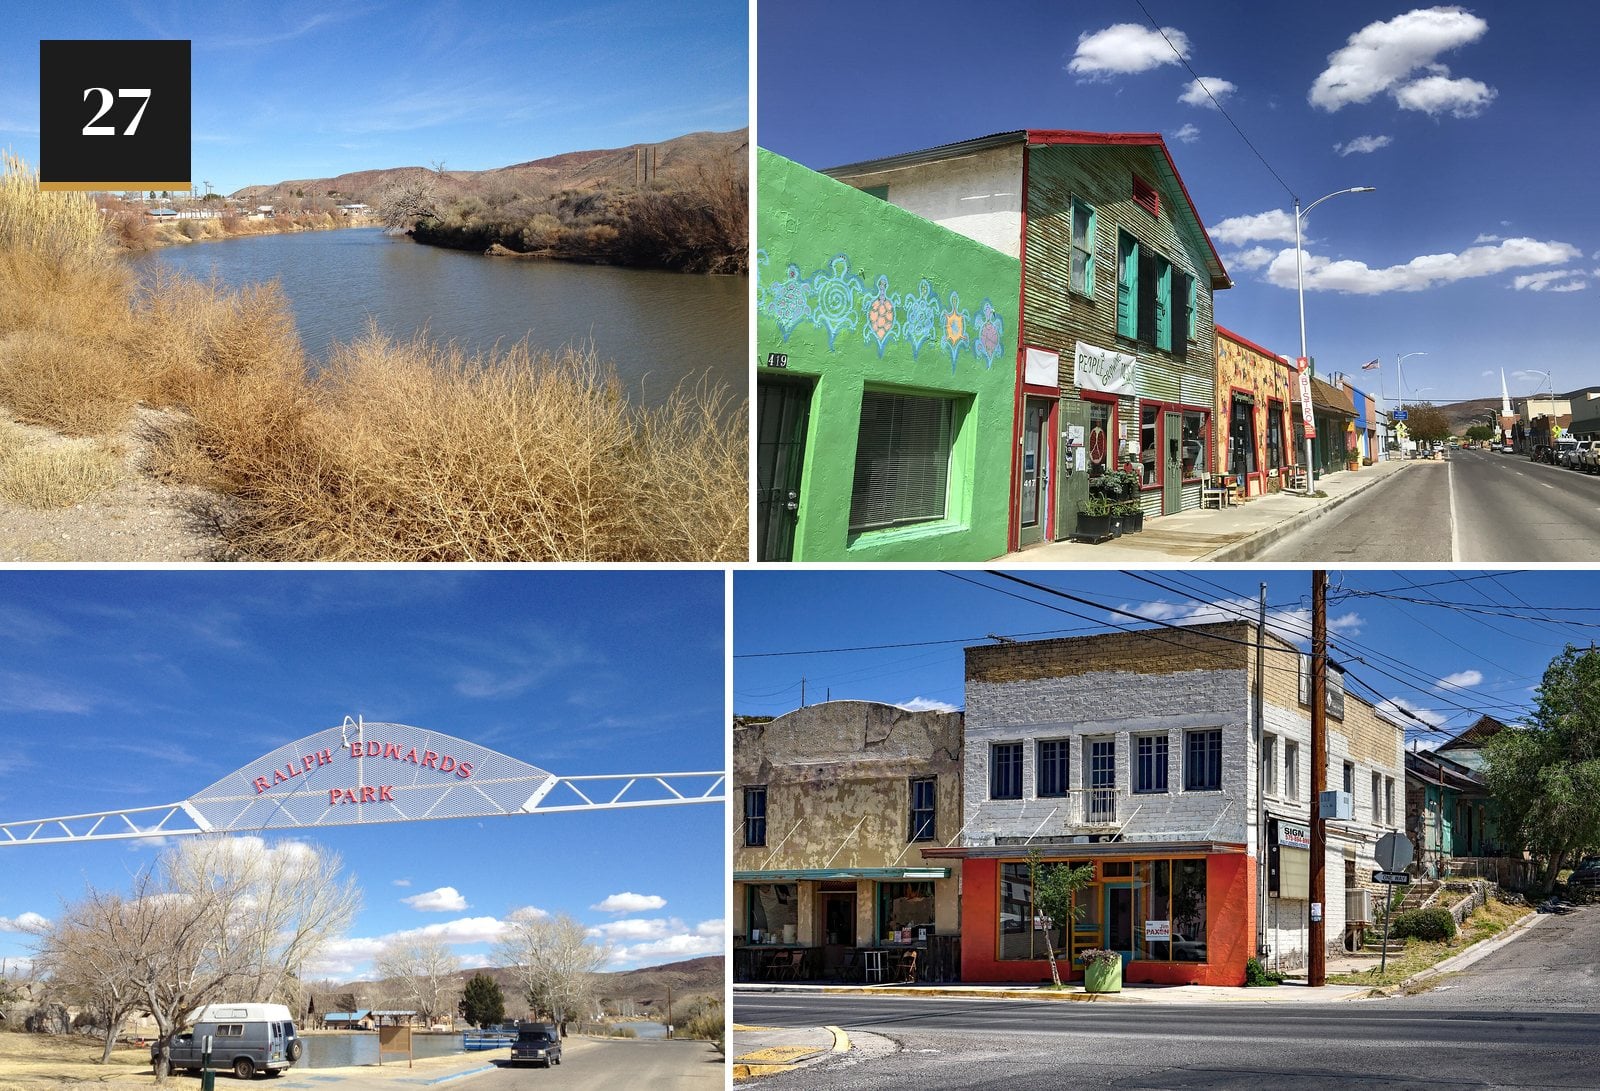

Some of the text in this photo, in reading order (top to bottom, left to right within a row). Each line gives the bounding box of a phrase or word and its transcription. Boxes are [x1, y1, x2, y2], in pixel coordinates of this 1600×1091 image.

[768, 354, 787, 367] 419
[1301, 378, 1313, 423] BISTRO
[1023, 479, 1036, 487] 417
[252, 740, 475, 795] RALPH EDWARDS
[328, 784, 395, 806] PARK
[1284, 827, 1305, 838] SIGN
